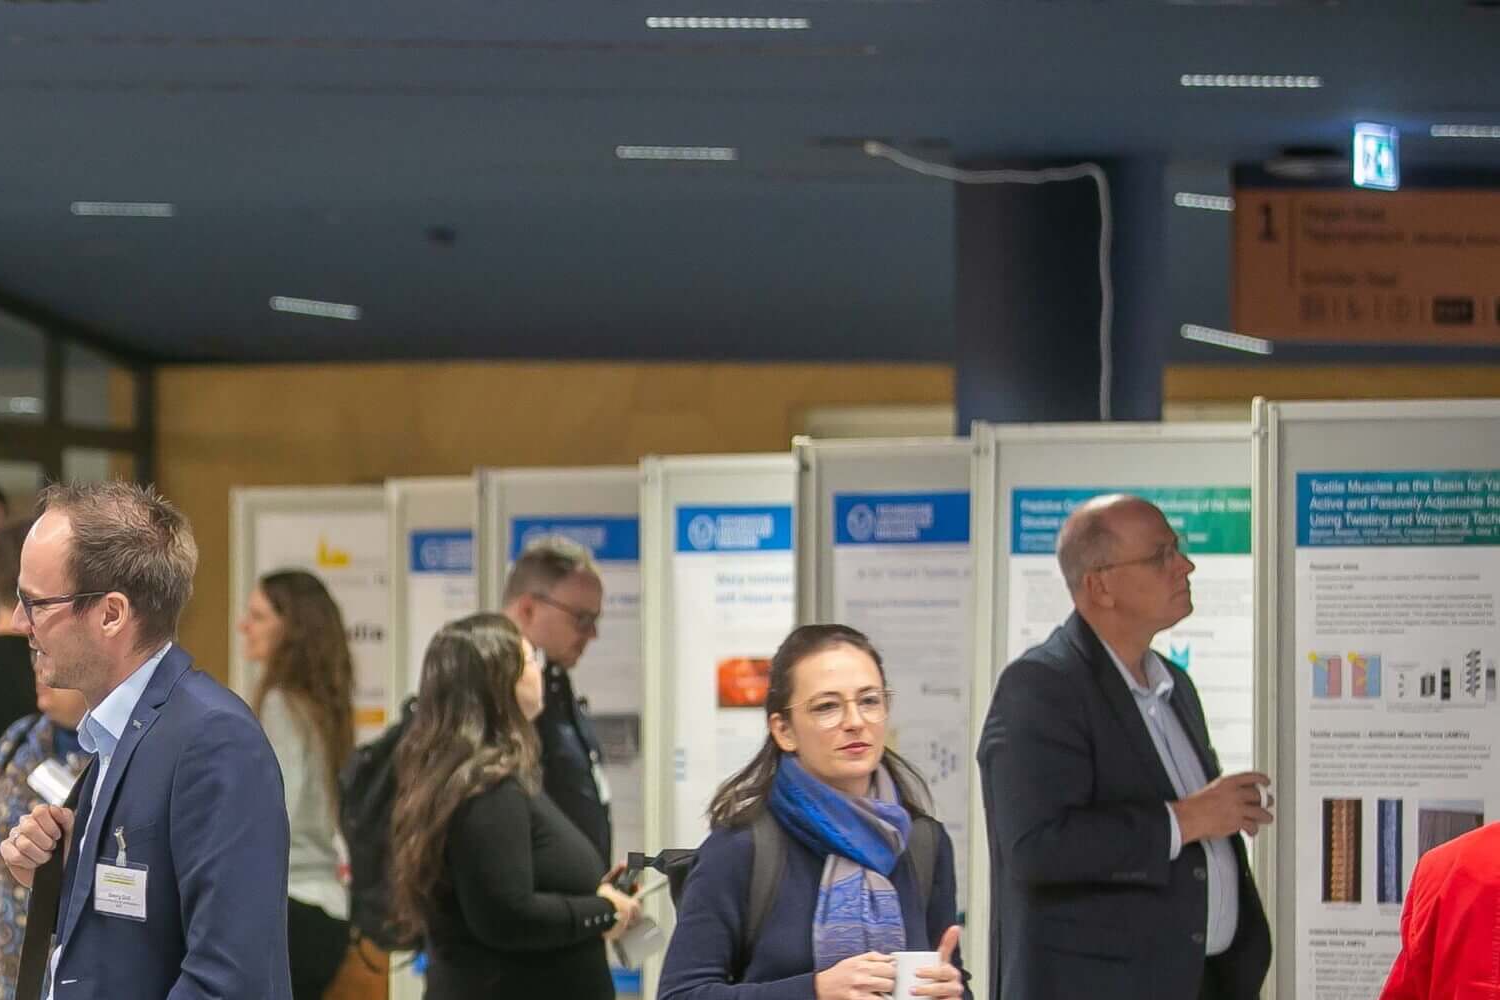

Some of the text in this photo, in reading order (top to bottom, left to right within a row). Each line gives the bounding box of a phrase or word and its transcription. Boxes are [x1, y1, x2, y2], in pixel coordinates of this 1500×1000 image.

[1259, 203, 1278, 242] 1
[1311, 479, 1345, 493] Textile
[1348, 479, 1393, 493] Muscles
[1396, 481, 1410, 493] as
[1413, 479, 1430, 493] the
[1433, 479, 1464, 493] Basis
[1467, 478, 1482, 493] for
[1310, 496, 1343, 510] Active
[1346, 496, 1367, 509] and
[1370, 496, 1422, 512] Passively
[1425, 496, 1484, 511] Adjustable
[1310, 512, 1500, 528] Using Twisting and Wrapping Tech
